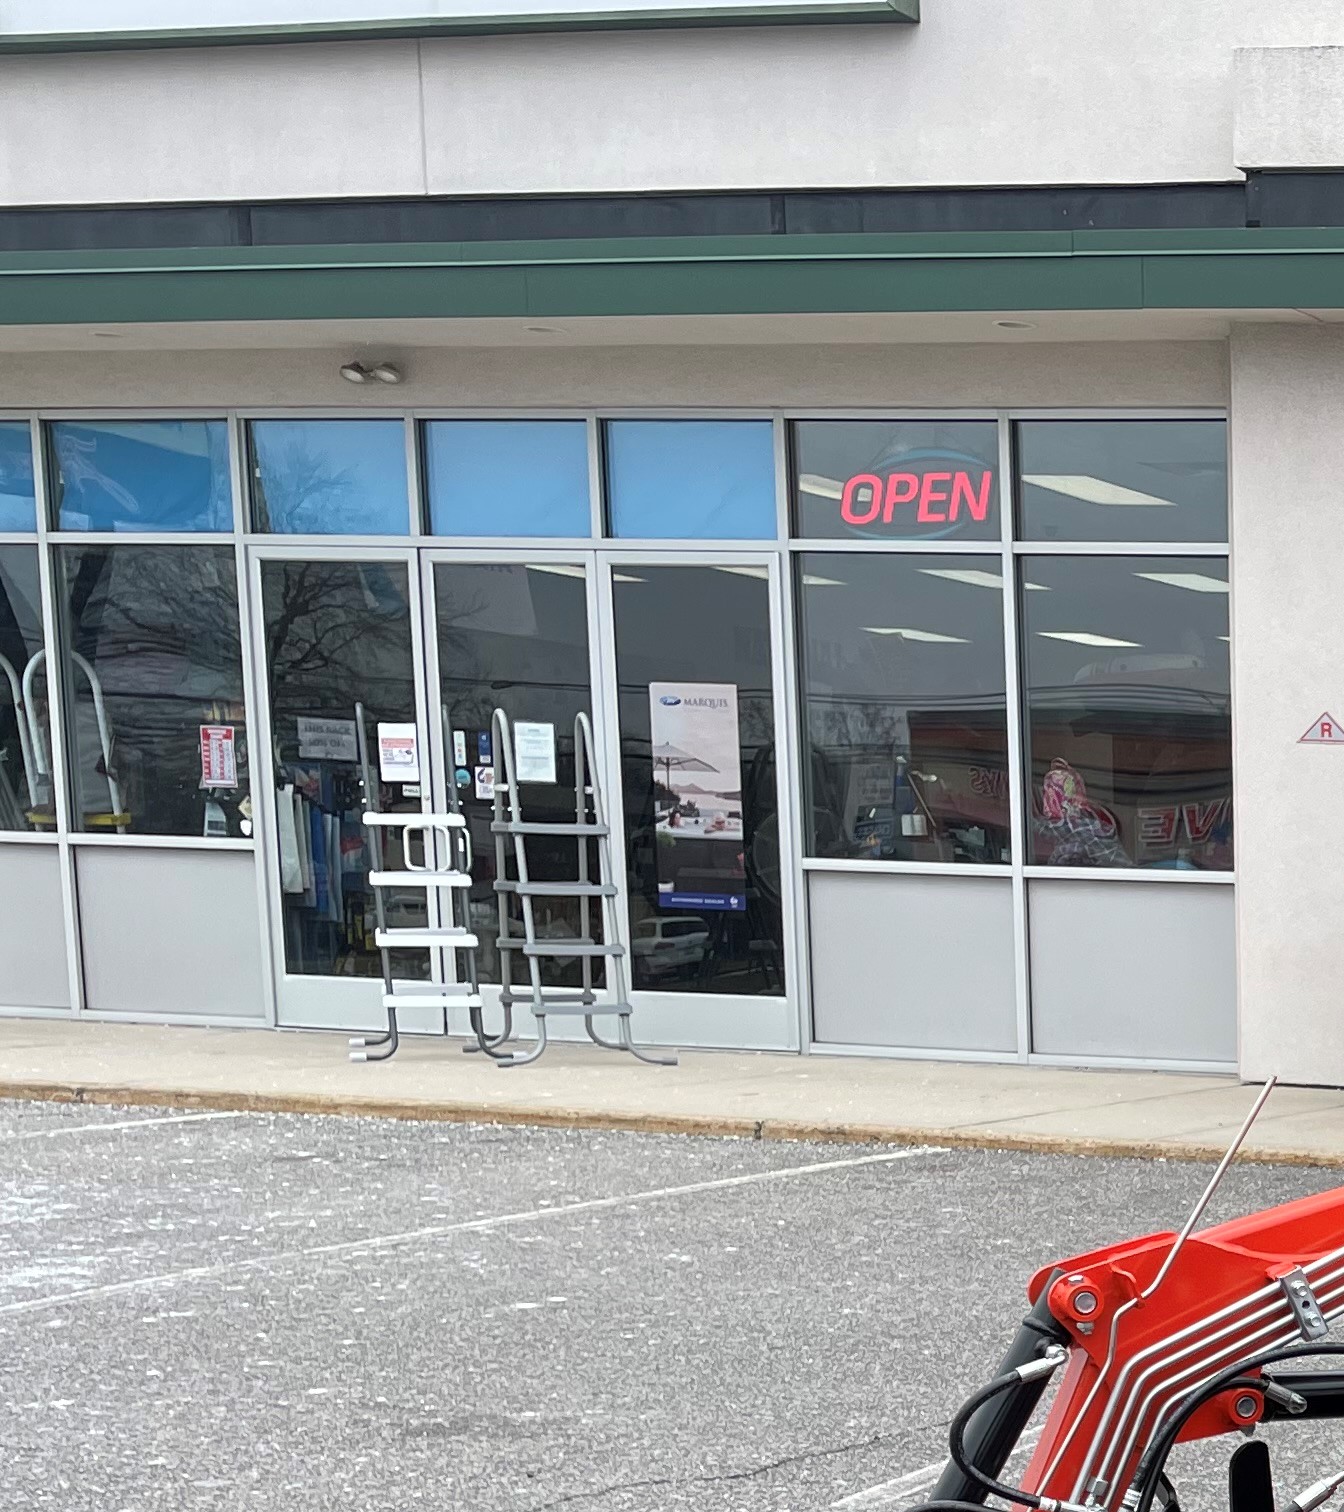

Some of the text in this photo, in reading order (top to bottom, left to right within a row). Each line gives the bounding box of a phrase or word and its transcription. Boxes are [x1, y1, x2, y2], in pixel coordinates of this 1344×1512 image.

[840, 470, 992, 525] OPEN
[683, 698, 729, 709] MARQUIS
[1320, 722, 1333, 739] R
